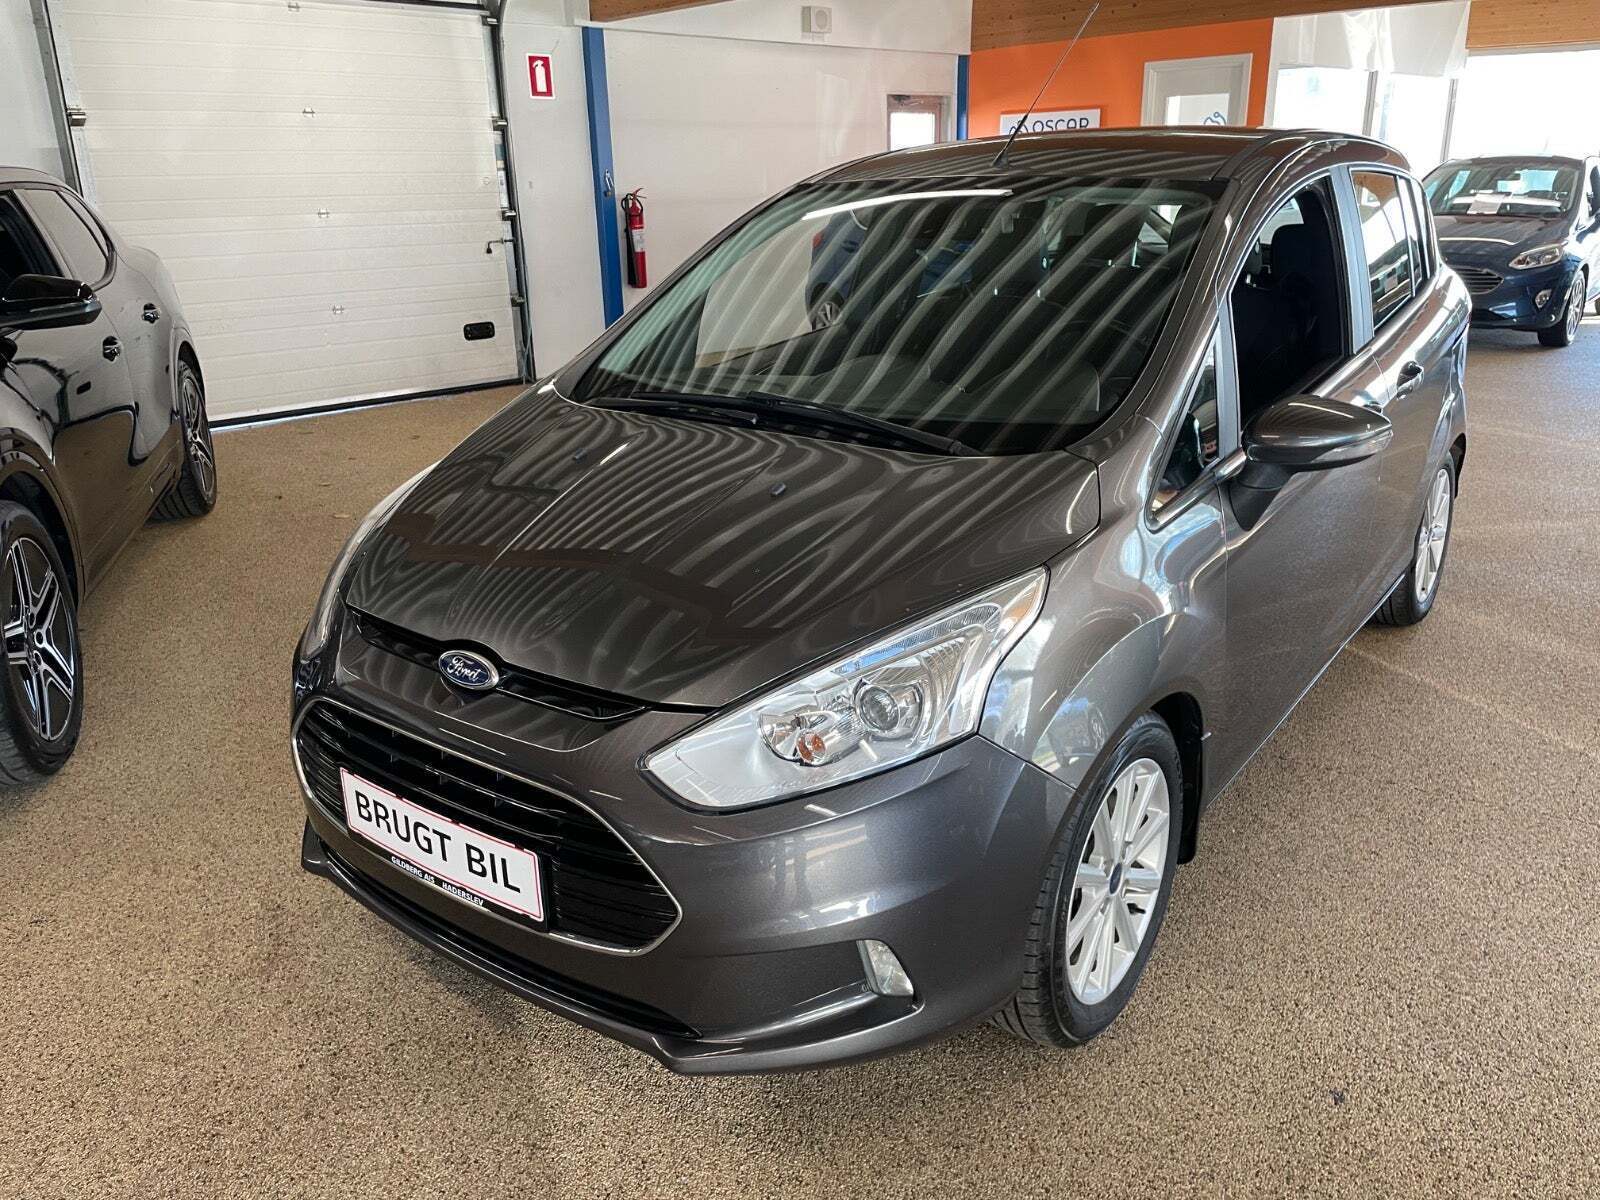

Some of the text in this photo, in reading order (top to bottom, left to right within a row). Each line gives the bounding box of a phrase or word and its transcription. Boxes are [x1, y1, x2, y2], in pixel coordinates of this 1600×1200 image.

[1032, 117, 1090, 132] OSCAR
[446, 655, 488, 682] Ford
[354, 789, 521, 894] BRUGT BIL
[391, 856, 423, 878] GILDBERG
[442, 881, 484, 906] HADERSLEV
